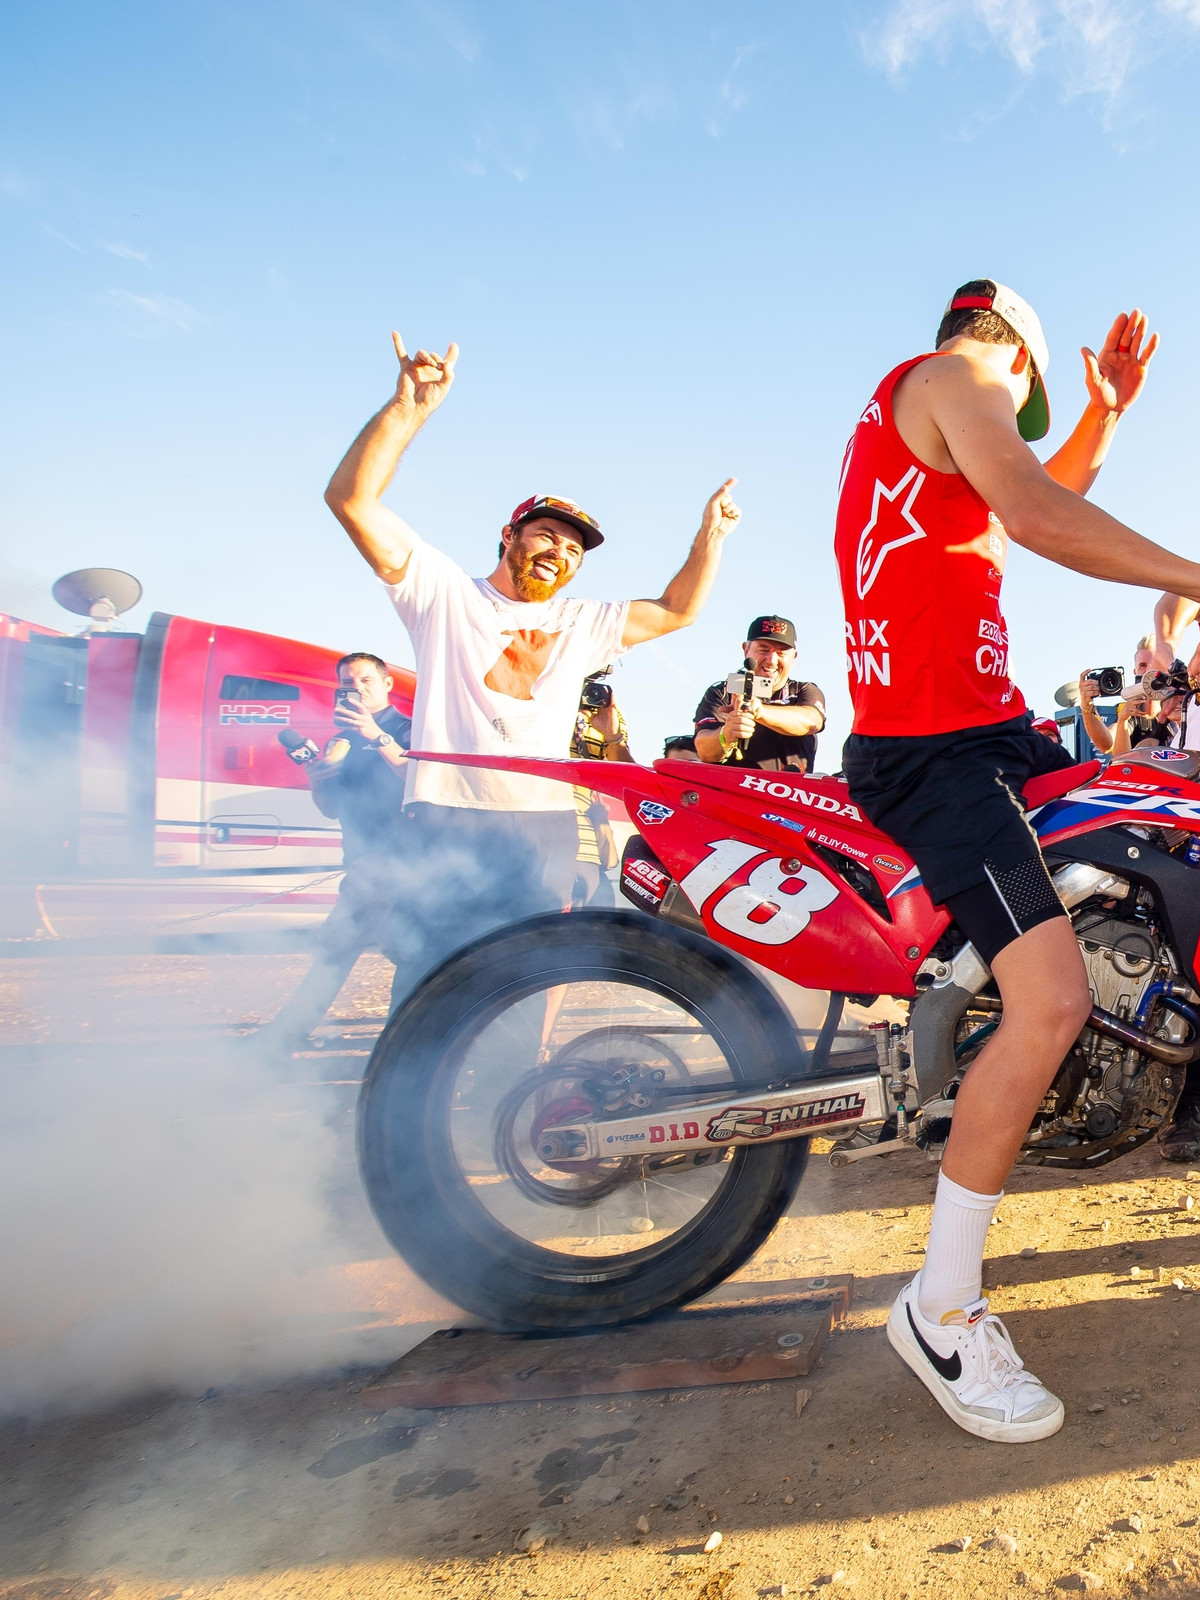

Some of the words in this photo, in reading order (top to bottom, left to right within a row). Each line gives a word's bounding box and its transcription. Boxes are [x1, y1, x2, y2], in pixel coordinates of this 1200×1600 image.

[219, 705, 290, 725] HRC
[739, 775, 862, 822] HONDA
[1097, 779, 1184, 797] 250R
[841, 843, 868, 859] Power
[875, 857, 892, 868] Twin
[891, 863, 904, 871] Air
[627, 866, 660, 891] Lawrence
[624, 878, 660, 904] CHAMPION
[680, 839, 840, 945] 18
[710, 1095, 862, 1140] RENTHAL
[614, 1133, 645, 1142] YUTAKA
[649, 1122, 699, 1143] D.I.D
